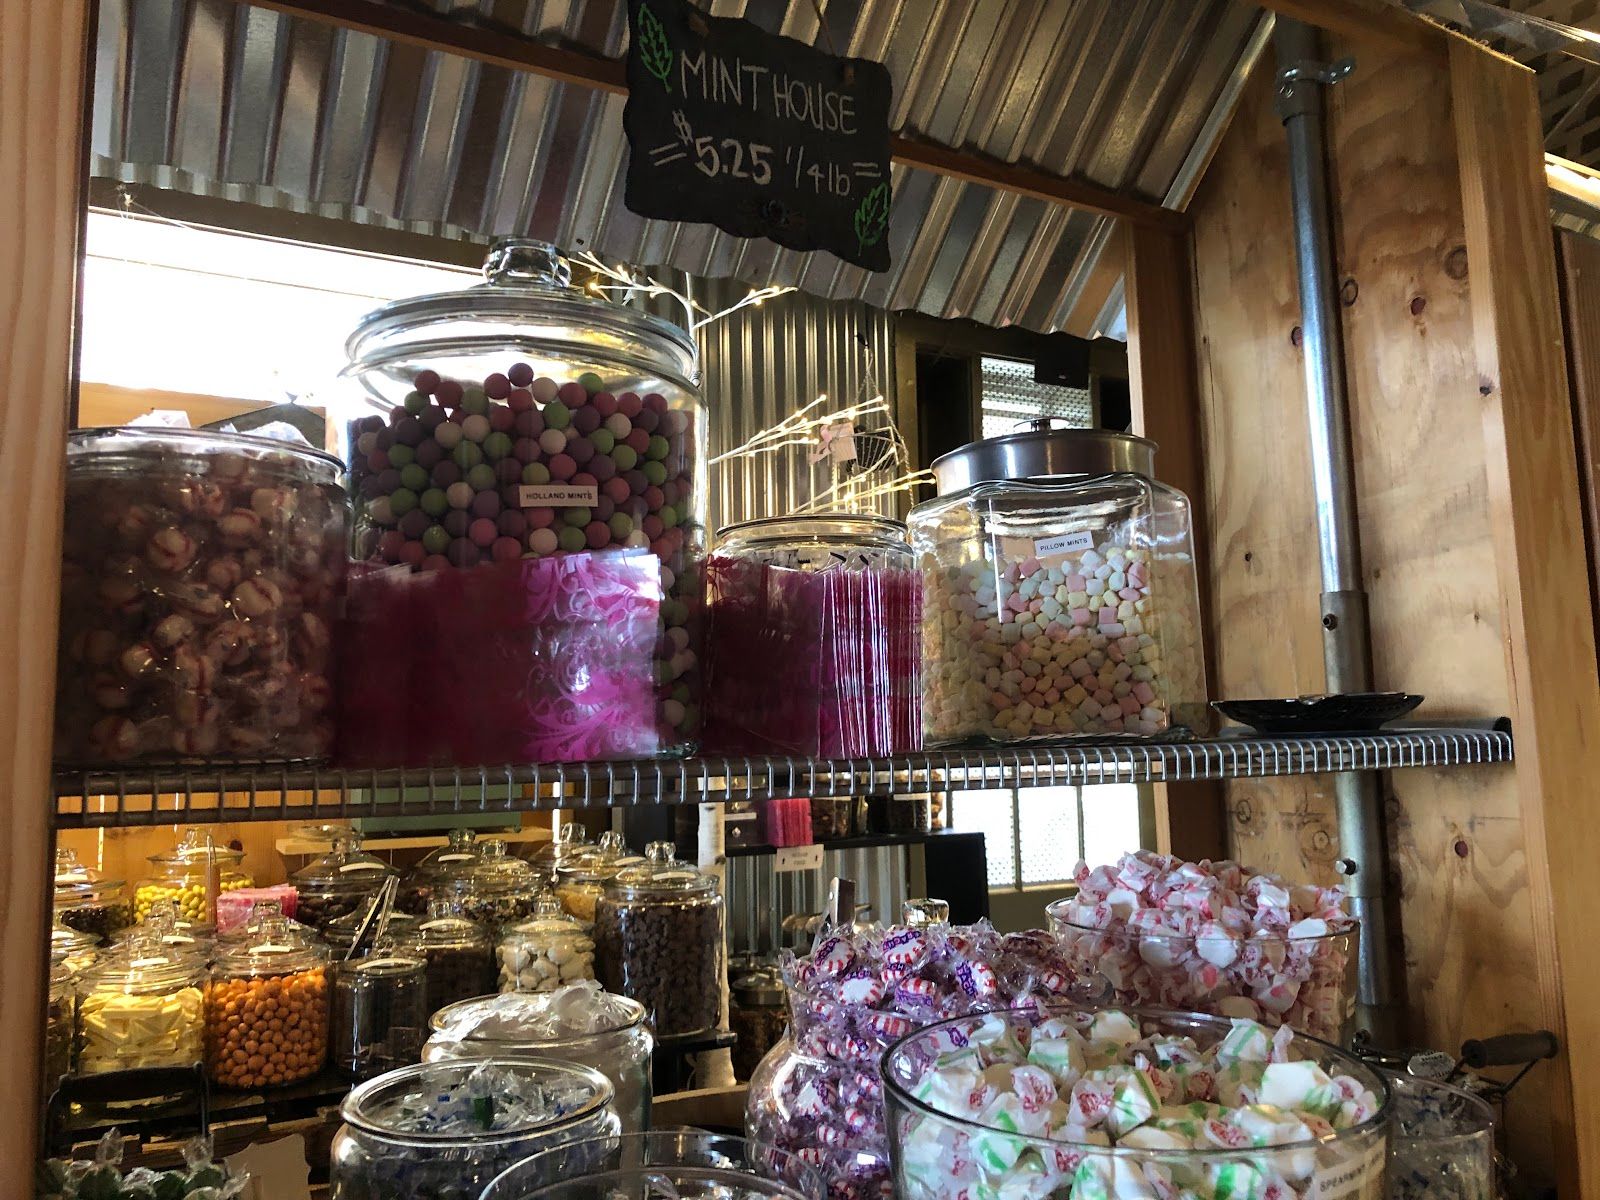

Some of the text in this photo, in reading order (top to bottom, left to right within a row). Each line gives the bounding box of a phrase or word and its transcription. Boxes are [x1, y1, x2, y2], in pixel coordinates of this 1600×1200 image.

[681, 50, 857, 134] MINT HOUSE
[672, 109, 775, 185] $5.25
[526, 492, 566, 500] HOLLAND
[1040, 537, 1088, 551] PILLOW MINTS
